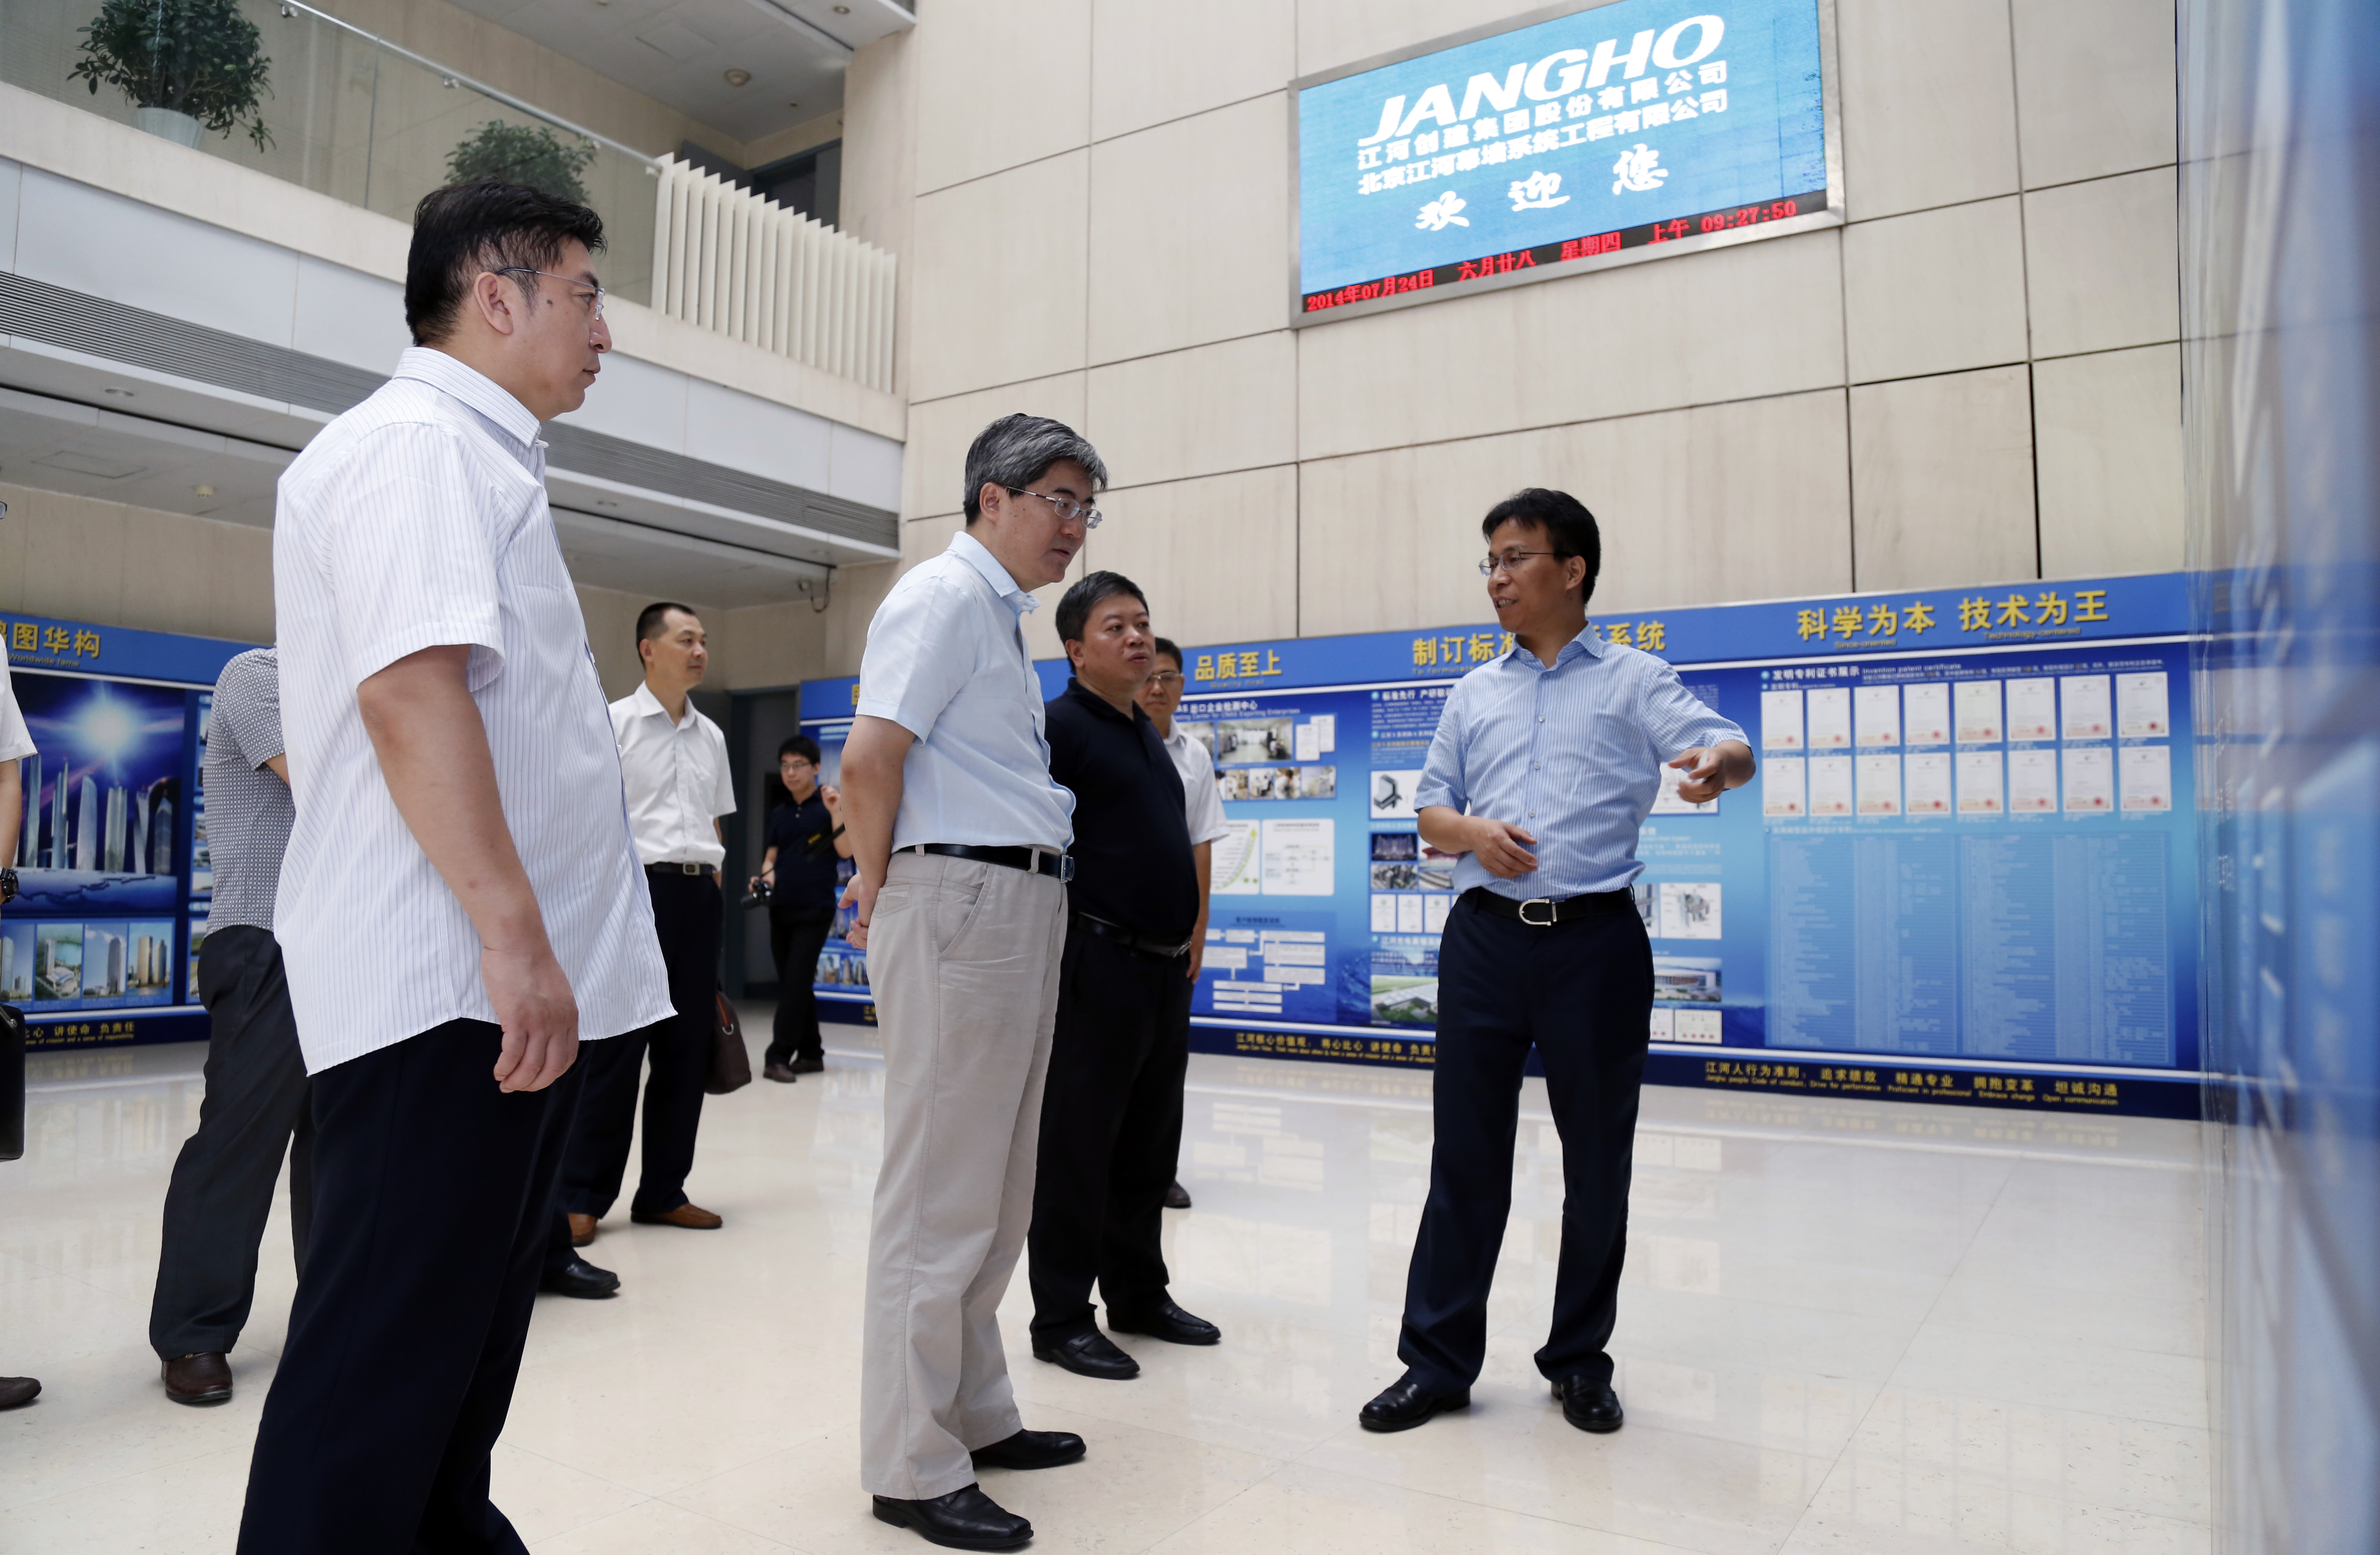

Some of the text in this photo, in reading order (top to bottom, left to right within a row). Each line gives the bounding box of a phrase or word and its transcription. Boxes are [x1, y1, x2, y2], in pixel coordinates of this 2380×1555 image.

[1357, 14, 1725, 146] JANGHO
[1357, 60, 1727, 170] 江河创建集团股份有限公司
[1357, 88, 1727, 195] 北京江河幕墙系统工程有限公司
[1306, 200, 1797, 312] 2014年07月24日 六月廿八 星期四 上午 09:27:50
[1195, 649, 1283, 681] 品质至上
[1593, 620, 1665, 651] 系统
[1798, 590, 2109, 641] 科学为本 技术为王
